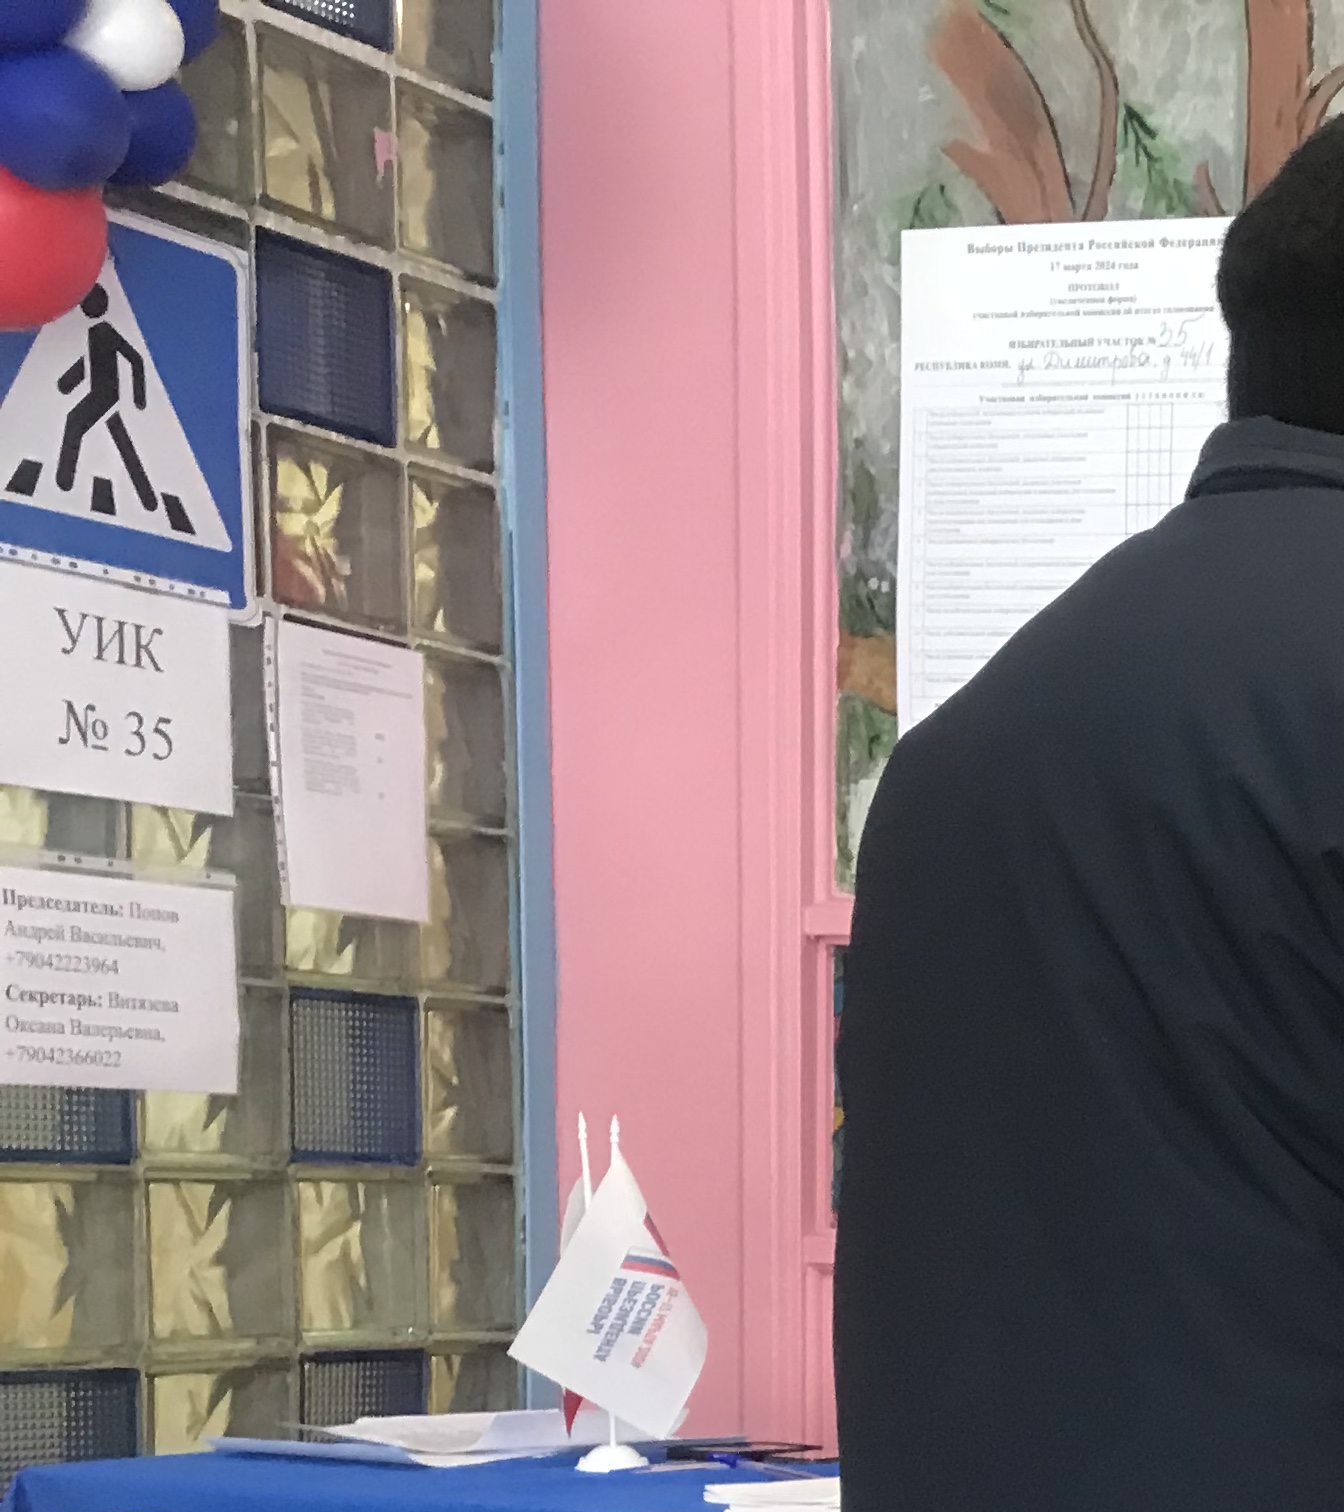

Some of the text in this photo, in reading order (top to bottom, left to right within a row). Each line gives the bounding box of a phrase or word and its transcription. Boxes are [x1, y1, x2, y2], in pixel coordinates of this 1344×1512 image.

[967, 243, 1013, 256] Выборы
[1017, 241, 1084, 255] Президента
[1088, 238, 1155, 250] Российской
[1158, 313, 1205, 347] 35
[53, 606, 165, 673] УИК
[58, 699, 173, 761] № 35
[2, 888, 180, 923] Председатель: Попов
[4, 920, 166, 952] Андрей Васильевич,
[5, 983, 103, 1010] Секретарь:
[5, 1014, 65, 1035] Оксана
